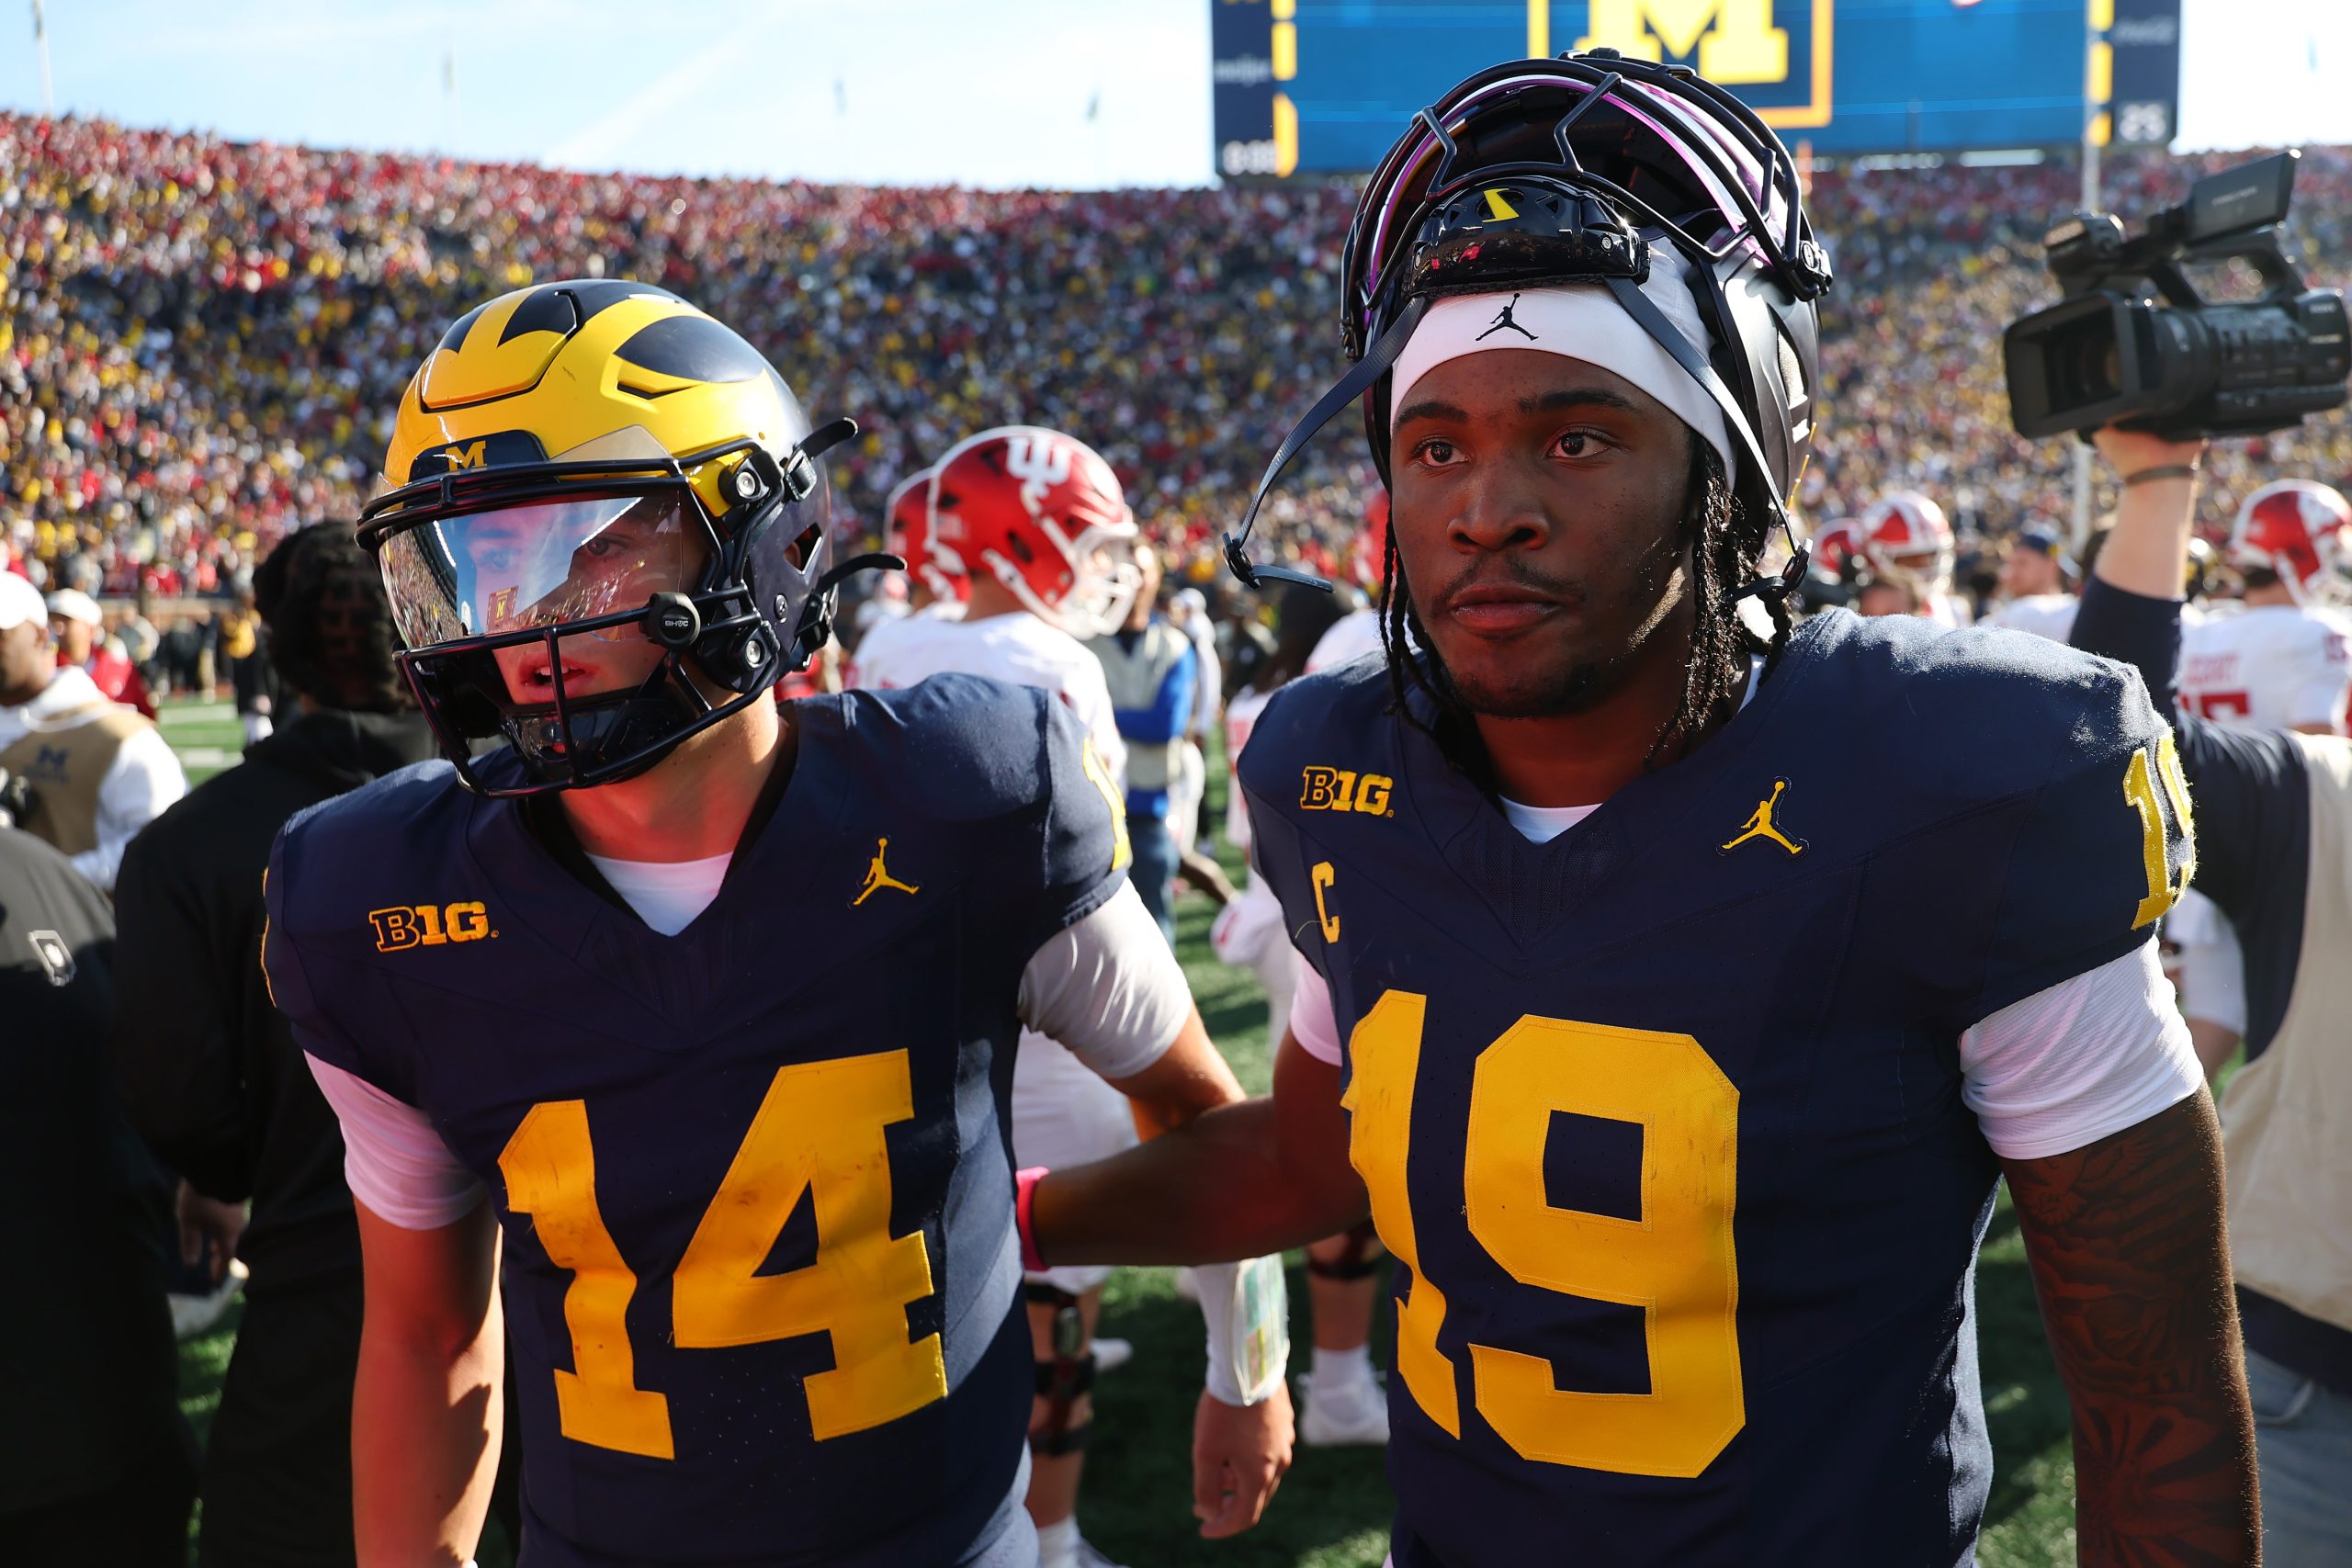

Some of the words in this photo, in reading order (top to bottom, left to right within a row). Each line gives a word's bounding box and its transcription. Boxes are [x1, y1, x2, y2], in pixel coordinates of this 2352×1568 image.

[1573, 0, 1788, 85] M
[446, 440, 487, 473] M
[1312, 862, 1340, 943] C
[497, 1048, 947, 1460] 14
[1340, 988, 1746, 1478] 19
